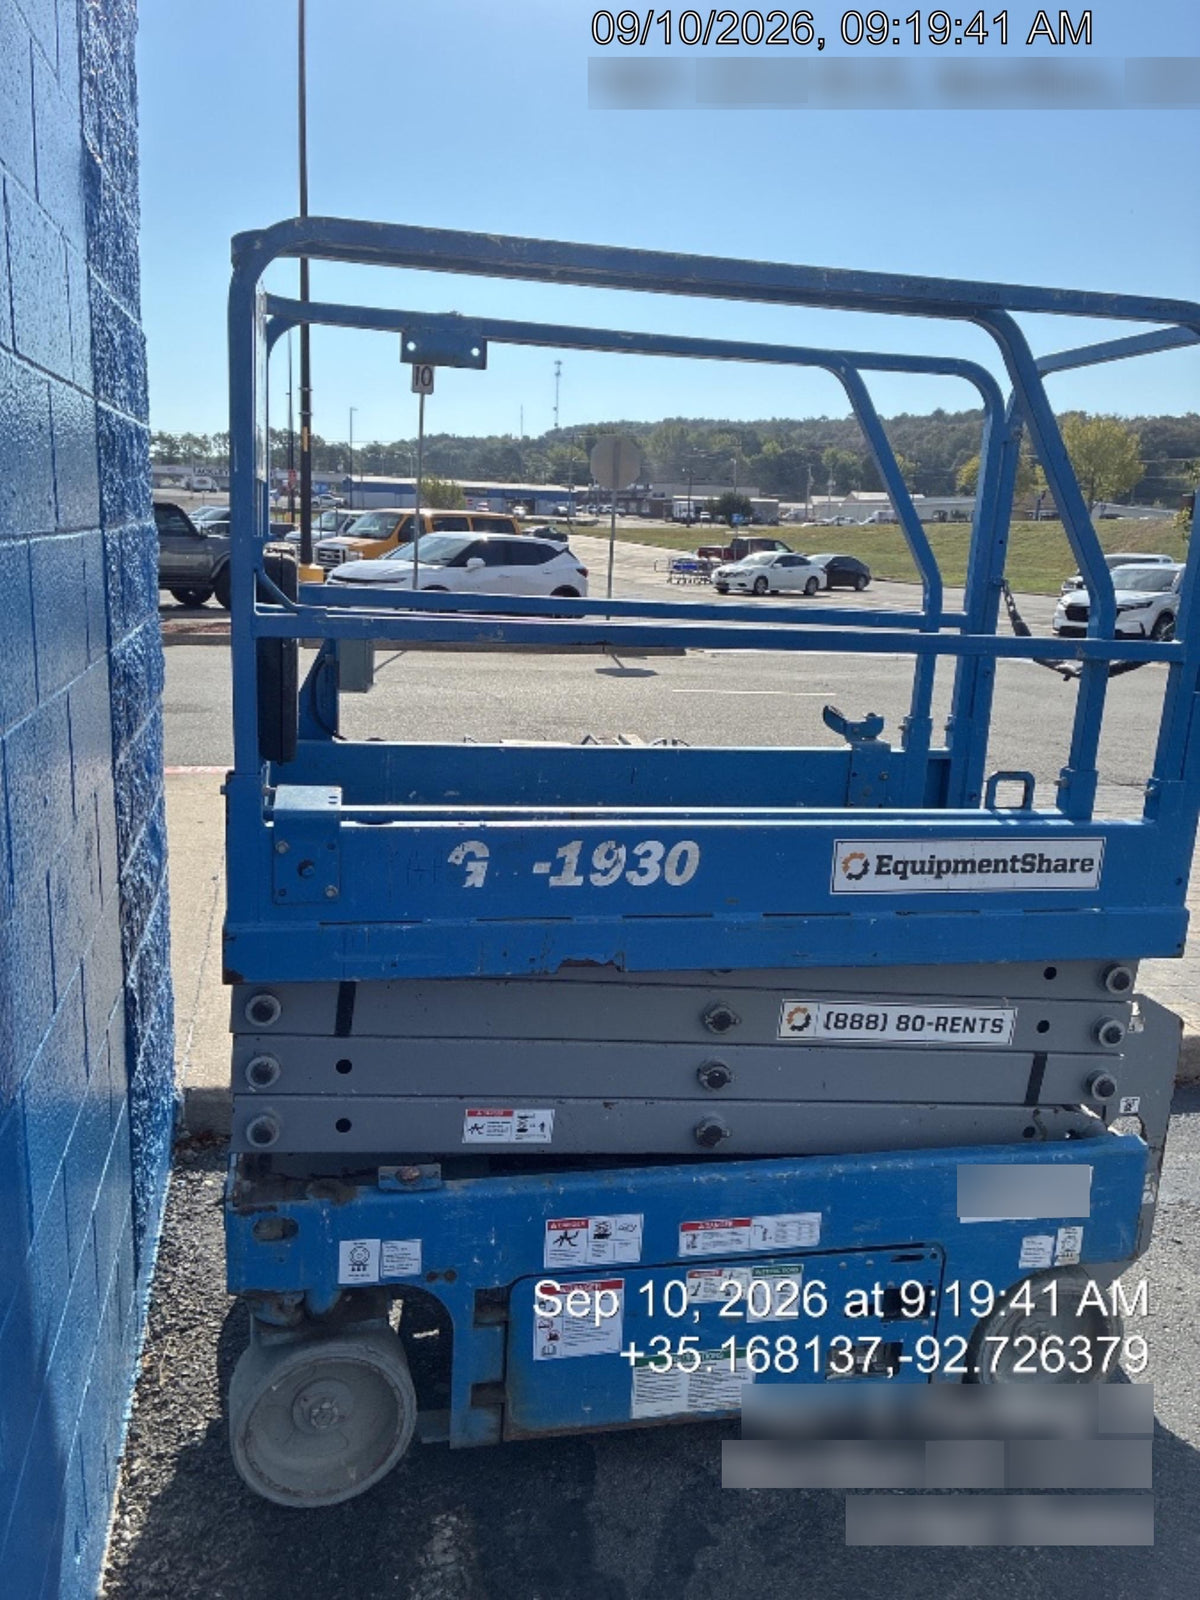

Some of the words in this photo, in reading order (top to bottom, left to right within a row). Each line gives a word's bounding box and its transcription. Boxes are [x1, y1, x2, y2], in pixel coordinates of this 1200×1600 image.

[415, 365, 433, 386] 10
[874, 852, 1096, 881] EquipmentShare
[823, 1010, 889, 1032] (888)
[895, 1014, 1005, 1034] 80-RENTS
